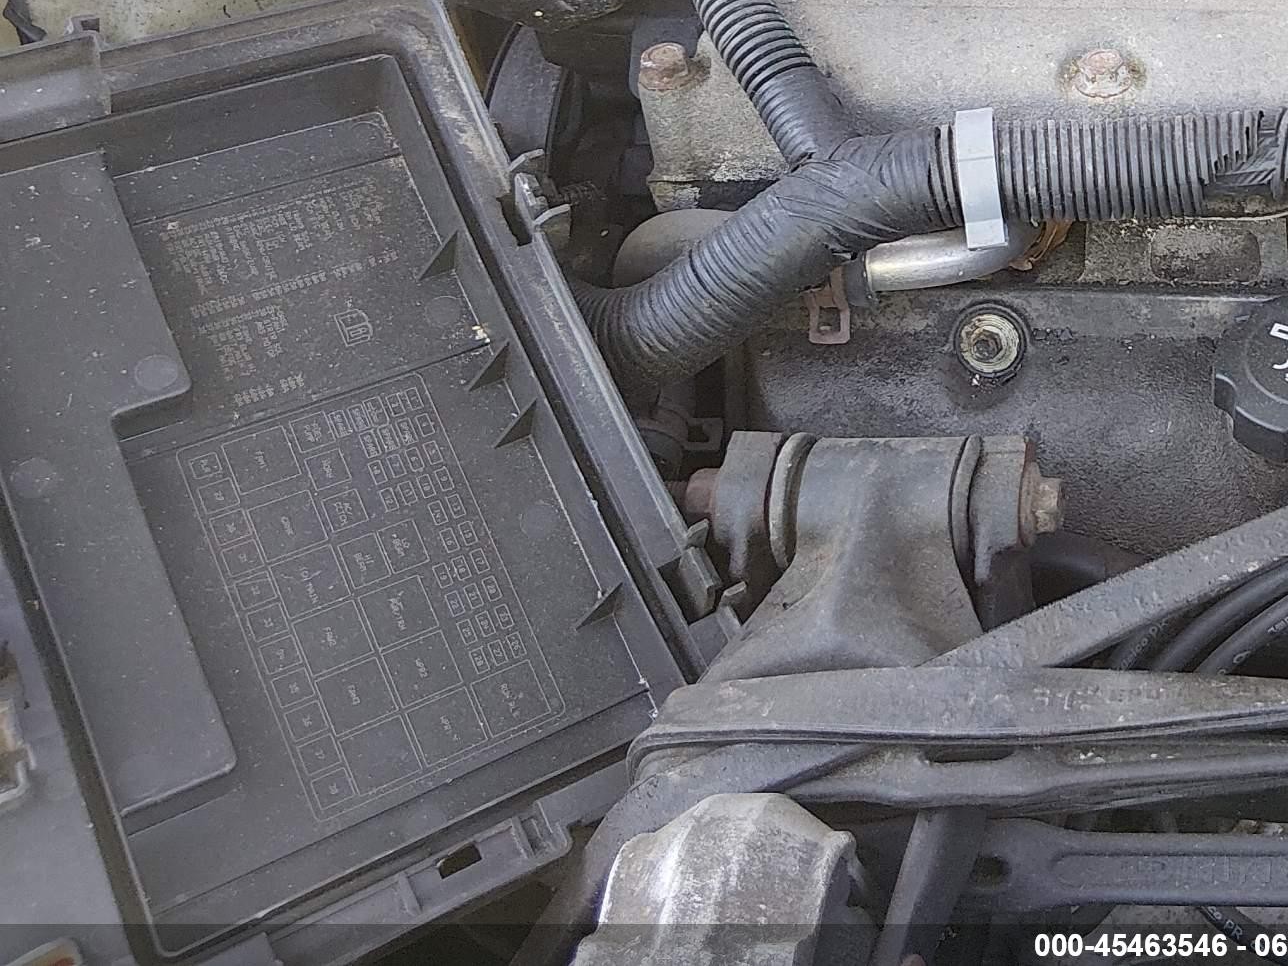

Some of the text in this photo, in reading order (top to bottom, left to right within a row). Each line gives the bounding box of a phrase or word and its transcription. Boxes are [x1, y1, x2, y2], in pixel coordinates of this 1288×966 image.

[473, 555, 485, 567] 17
[448, 597, 461, 610] 22
[492, 646, 503, 659] 27
